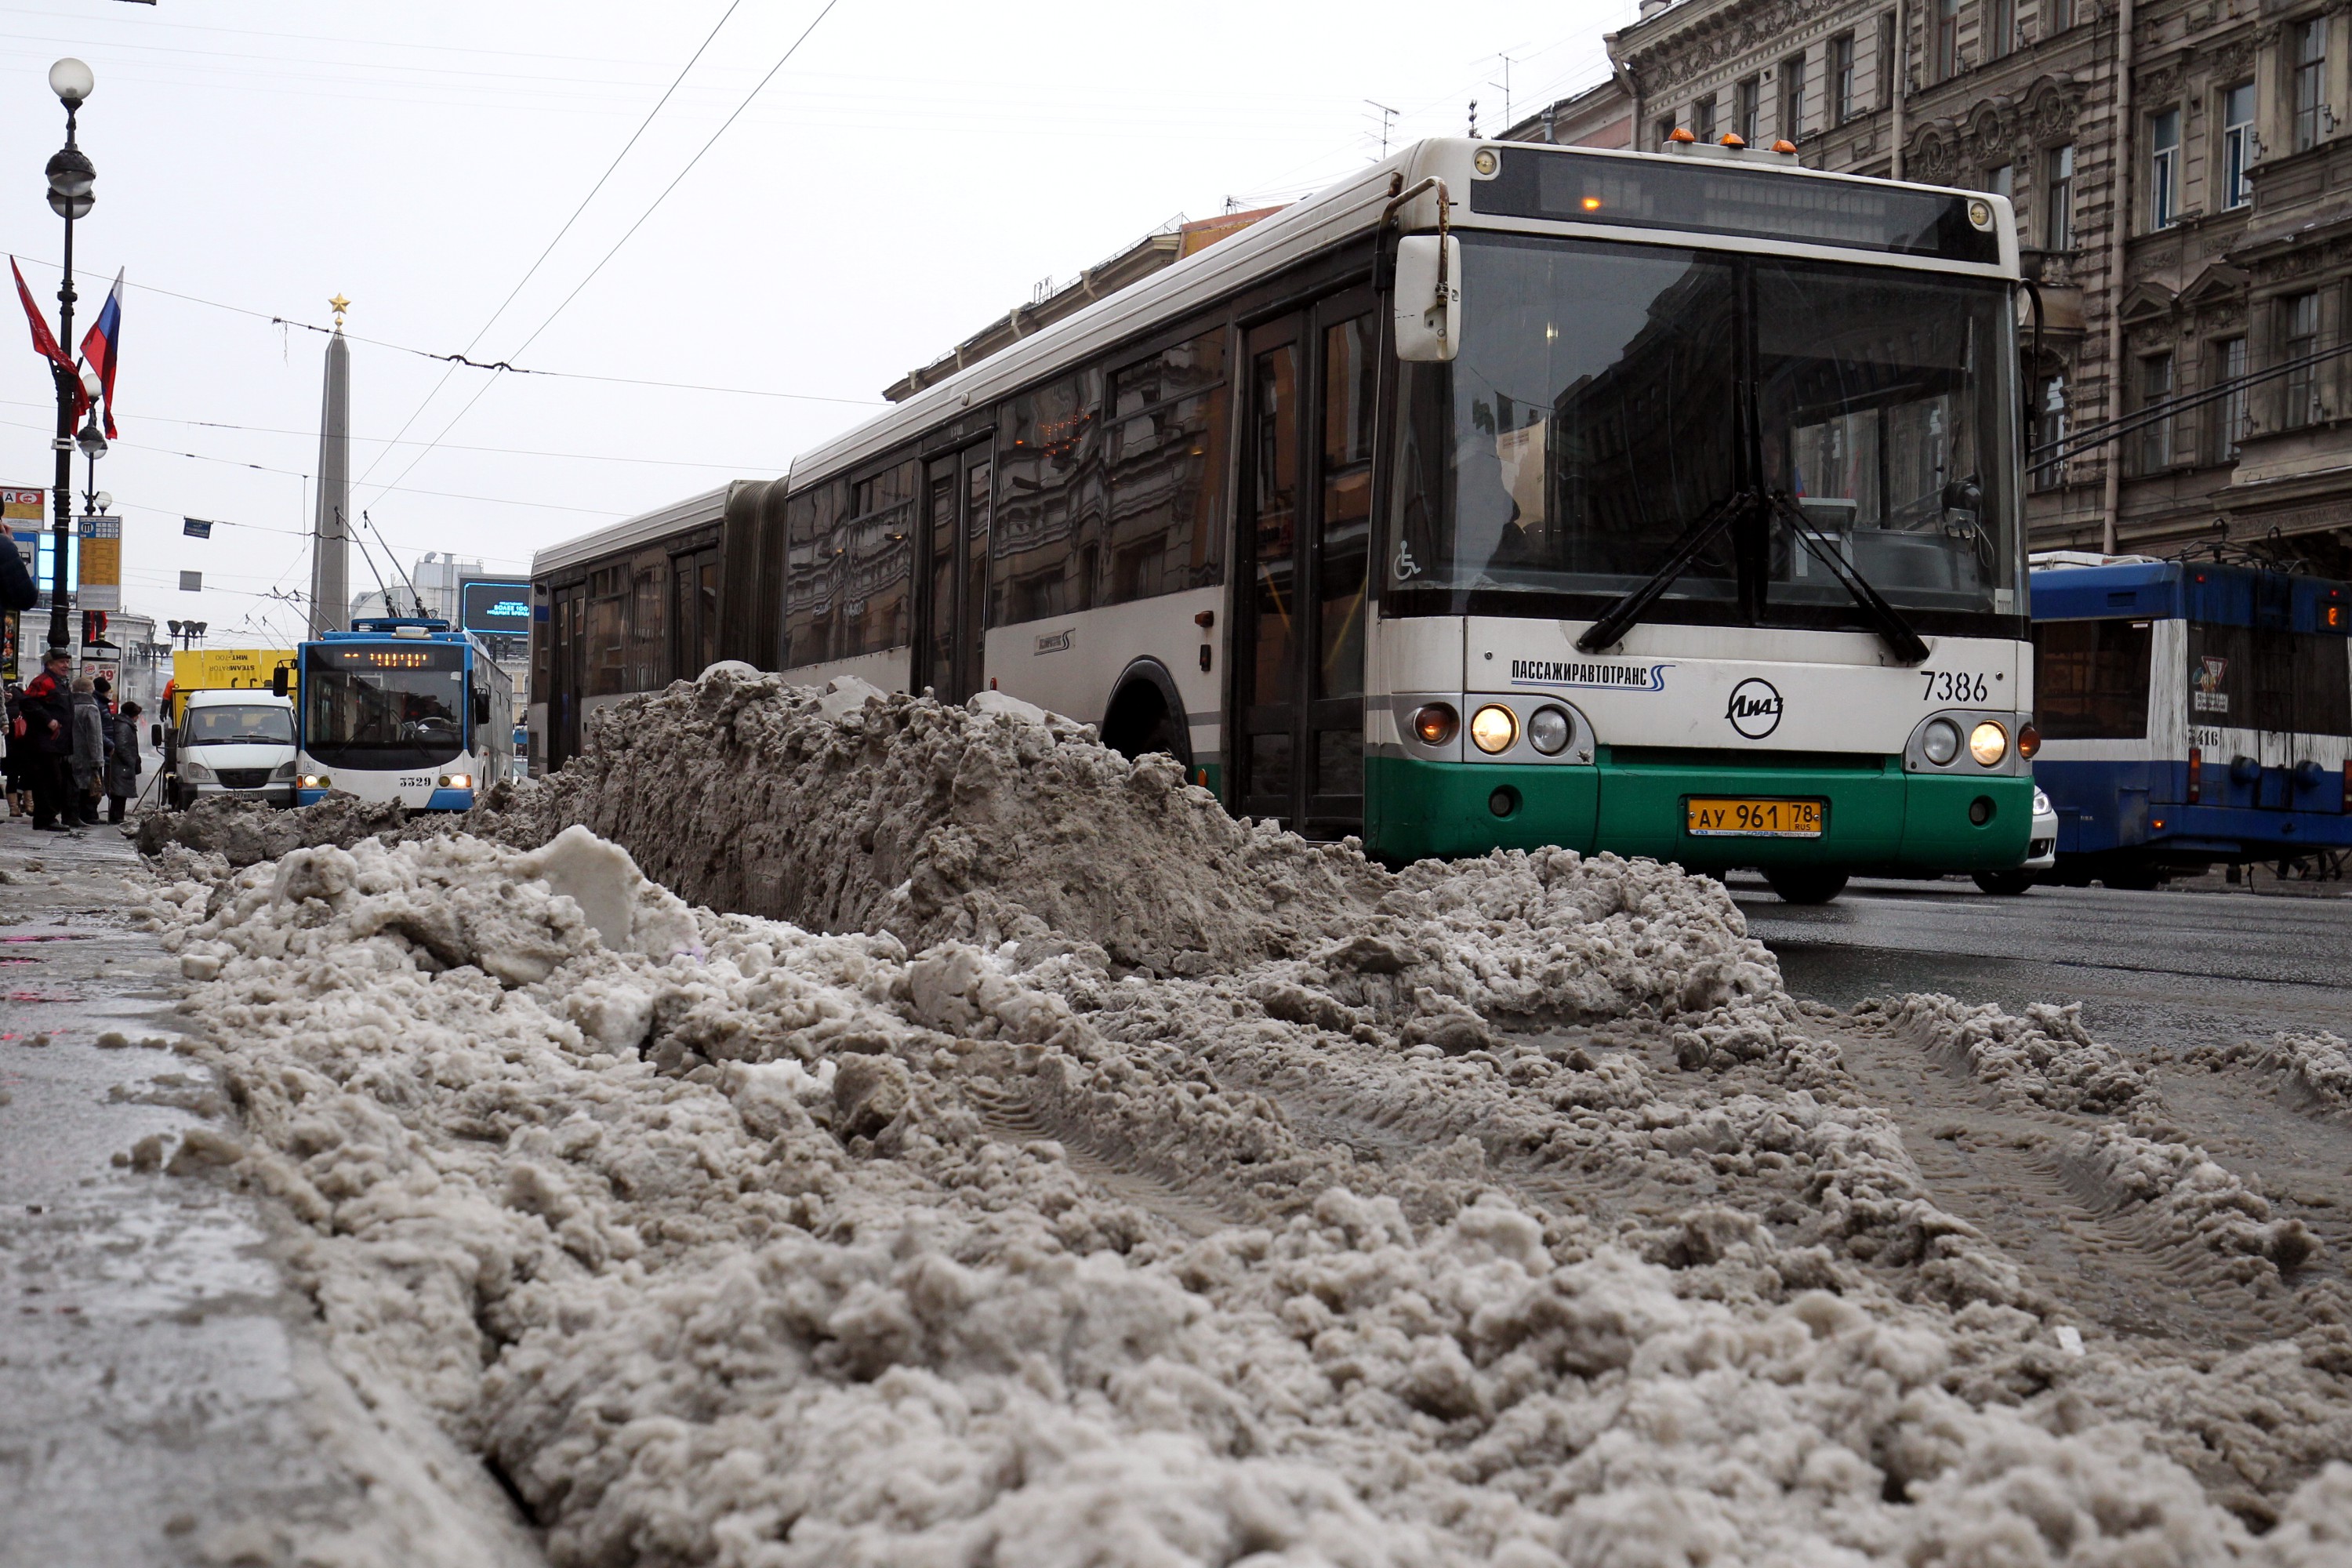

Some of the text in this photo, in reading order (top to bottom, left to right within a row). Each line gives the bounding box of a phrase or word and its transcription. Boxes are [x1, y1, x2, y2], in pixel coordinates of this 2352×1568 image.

[1512, 660, 1647, 686] ПАССАЖИРАВТОТРАНС
[1920, 671, 1987, 702] 7386
[400, 777, 431, 787] 3329
[1736, 804, 1777, 829] 961
[1792, 805, 1813, 822] 78
